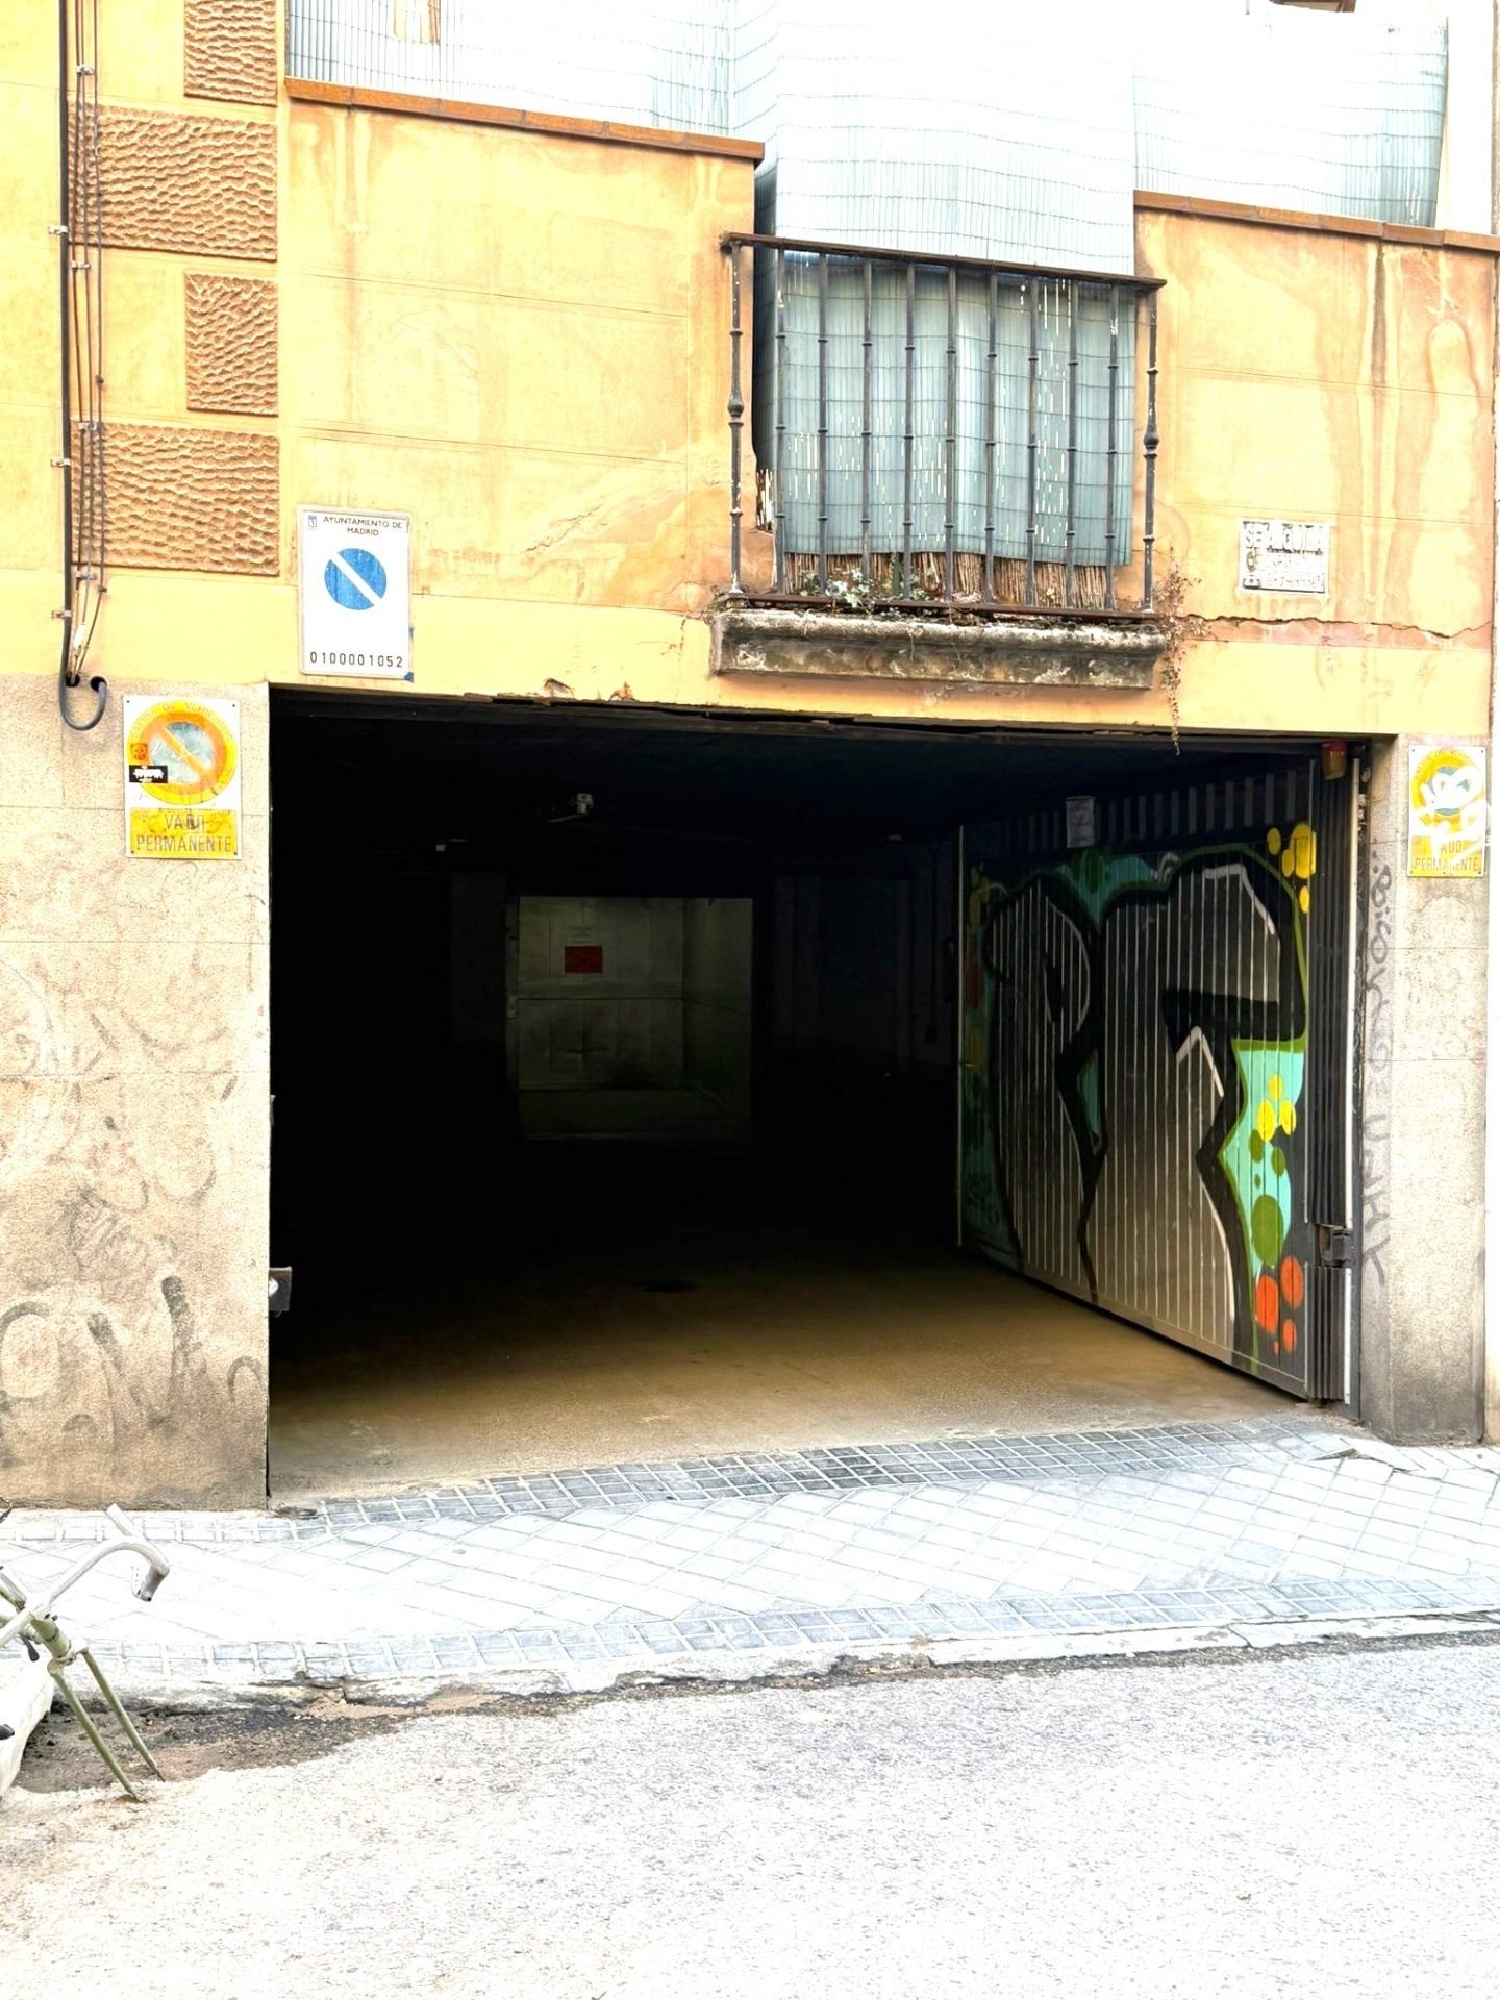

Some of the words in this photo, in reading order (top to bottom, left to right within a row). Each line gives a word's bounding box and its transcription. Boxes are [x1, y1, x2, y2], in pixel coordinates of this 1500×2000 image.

[323, 516, 390, 528] AYUNTAMIENTO
[392, 521, 403, 529] DE
[346, 526, 379, 536] MADRID
[309, 651, 403, 668] 0100001052
[136, 834, 232, 852] PERMANENTE
